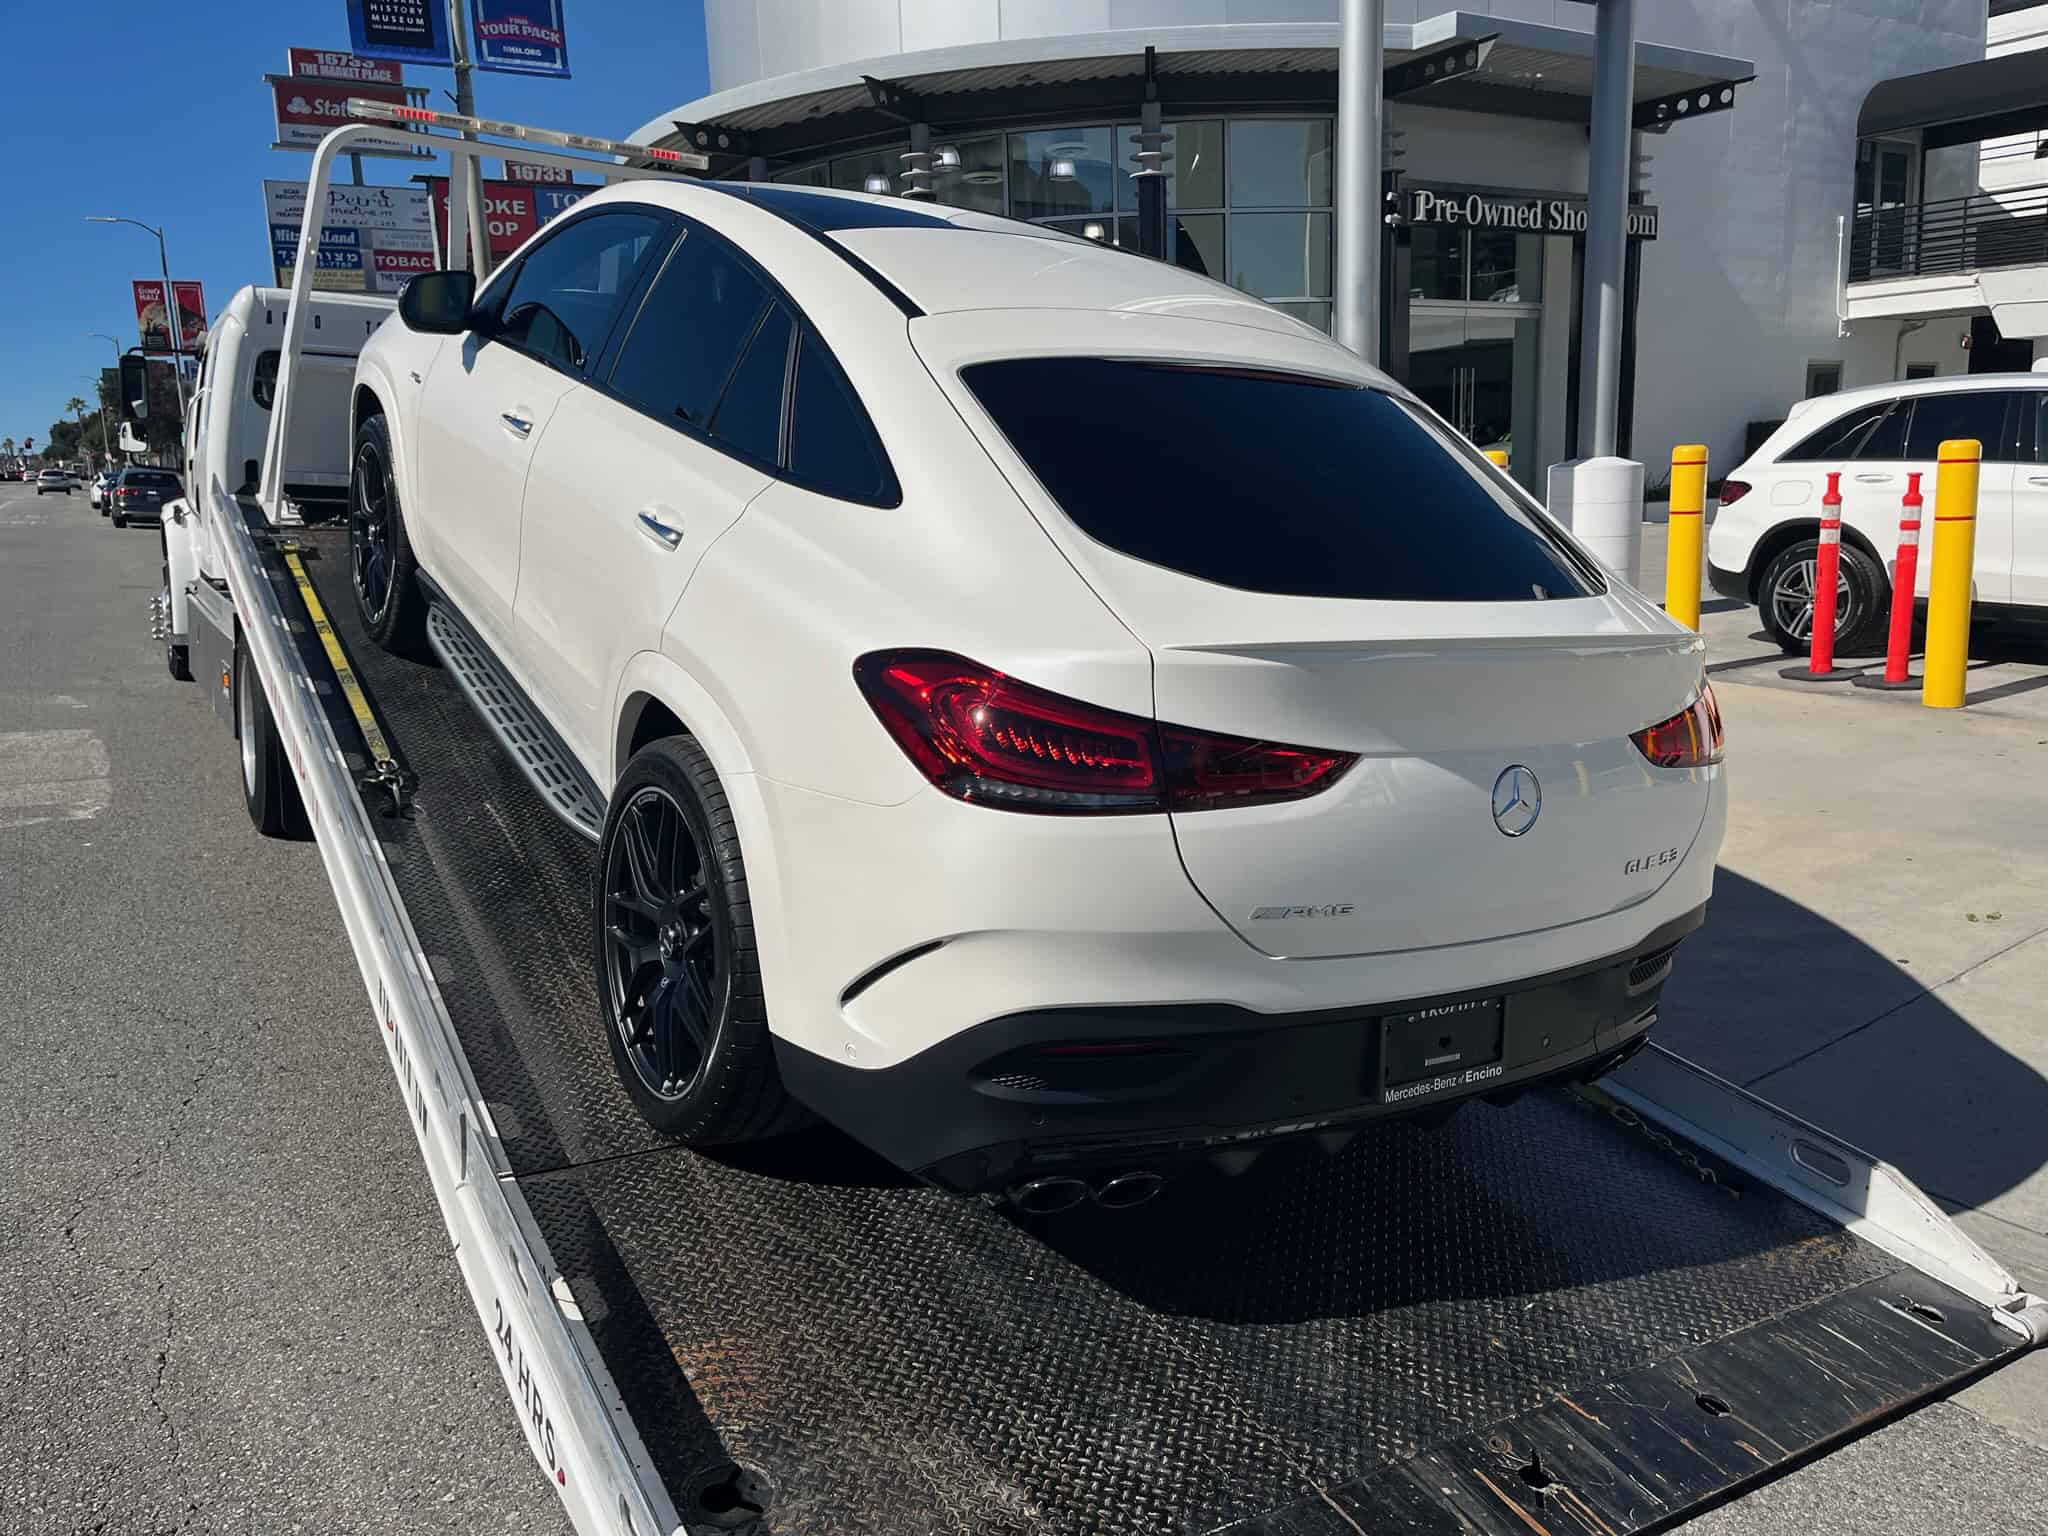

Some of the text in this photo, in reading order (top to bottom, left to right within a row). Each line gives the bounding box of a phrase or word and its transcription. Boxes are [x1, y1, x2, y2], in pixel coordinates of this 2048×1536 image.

[370, 3, 424, 15] HISTORY
[371, 13, 425, 25] MUSEUM
[480, 23, 561, 44] YOUR PACK
[300, 62, 393, 82] THE MARKET PLACE
[511, 165, 567, 182] 16733
[443, 196, 527, 215] SOKE
[546, 192, 585, 209] TO
[1413, 189, 1657, 237] Pre-Owned Shoom
[375, 254, 433, 268] TOBAC
[1384, 1076, 1458, 1104] Mercedes-Benz
[1465, 1065, 1503, 1083] Encino
[495, 1297, 556, 1471] 24 HRS
